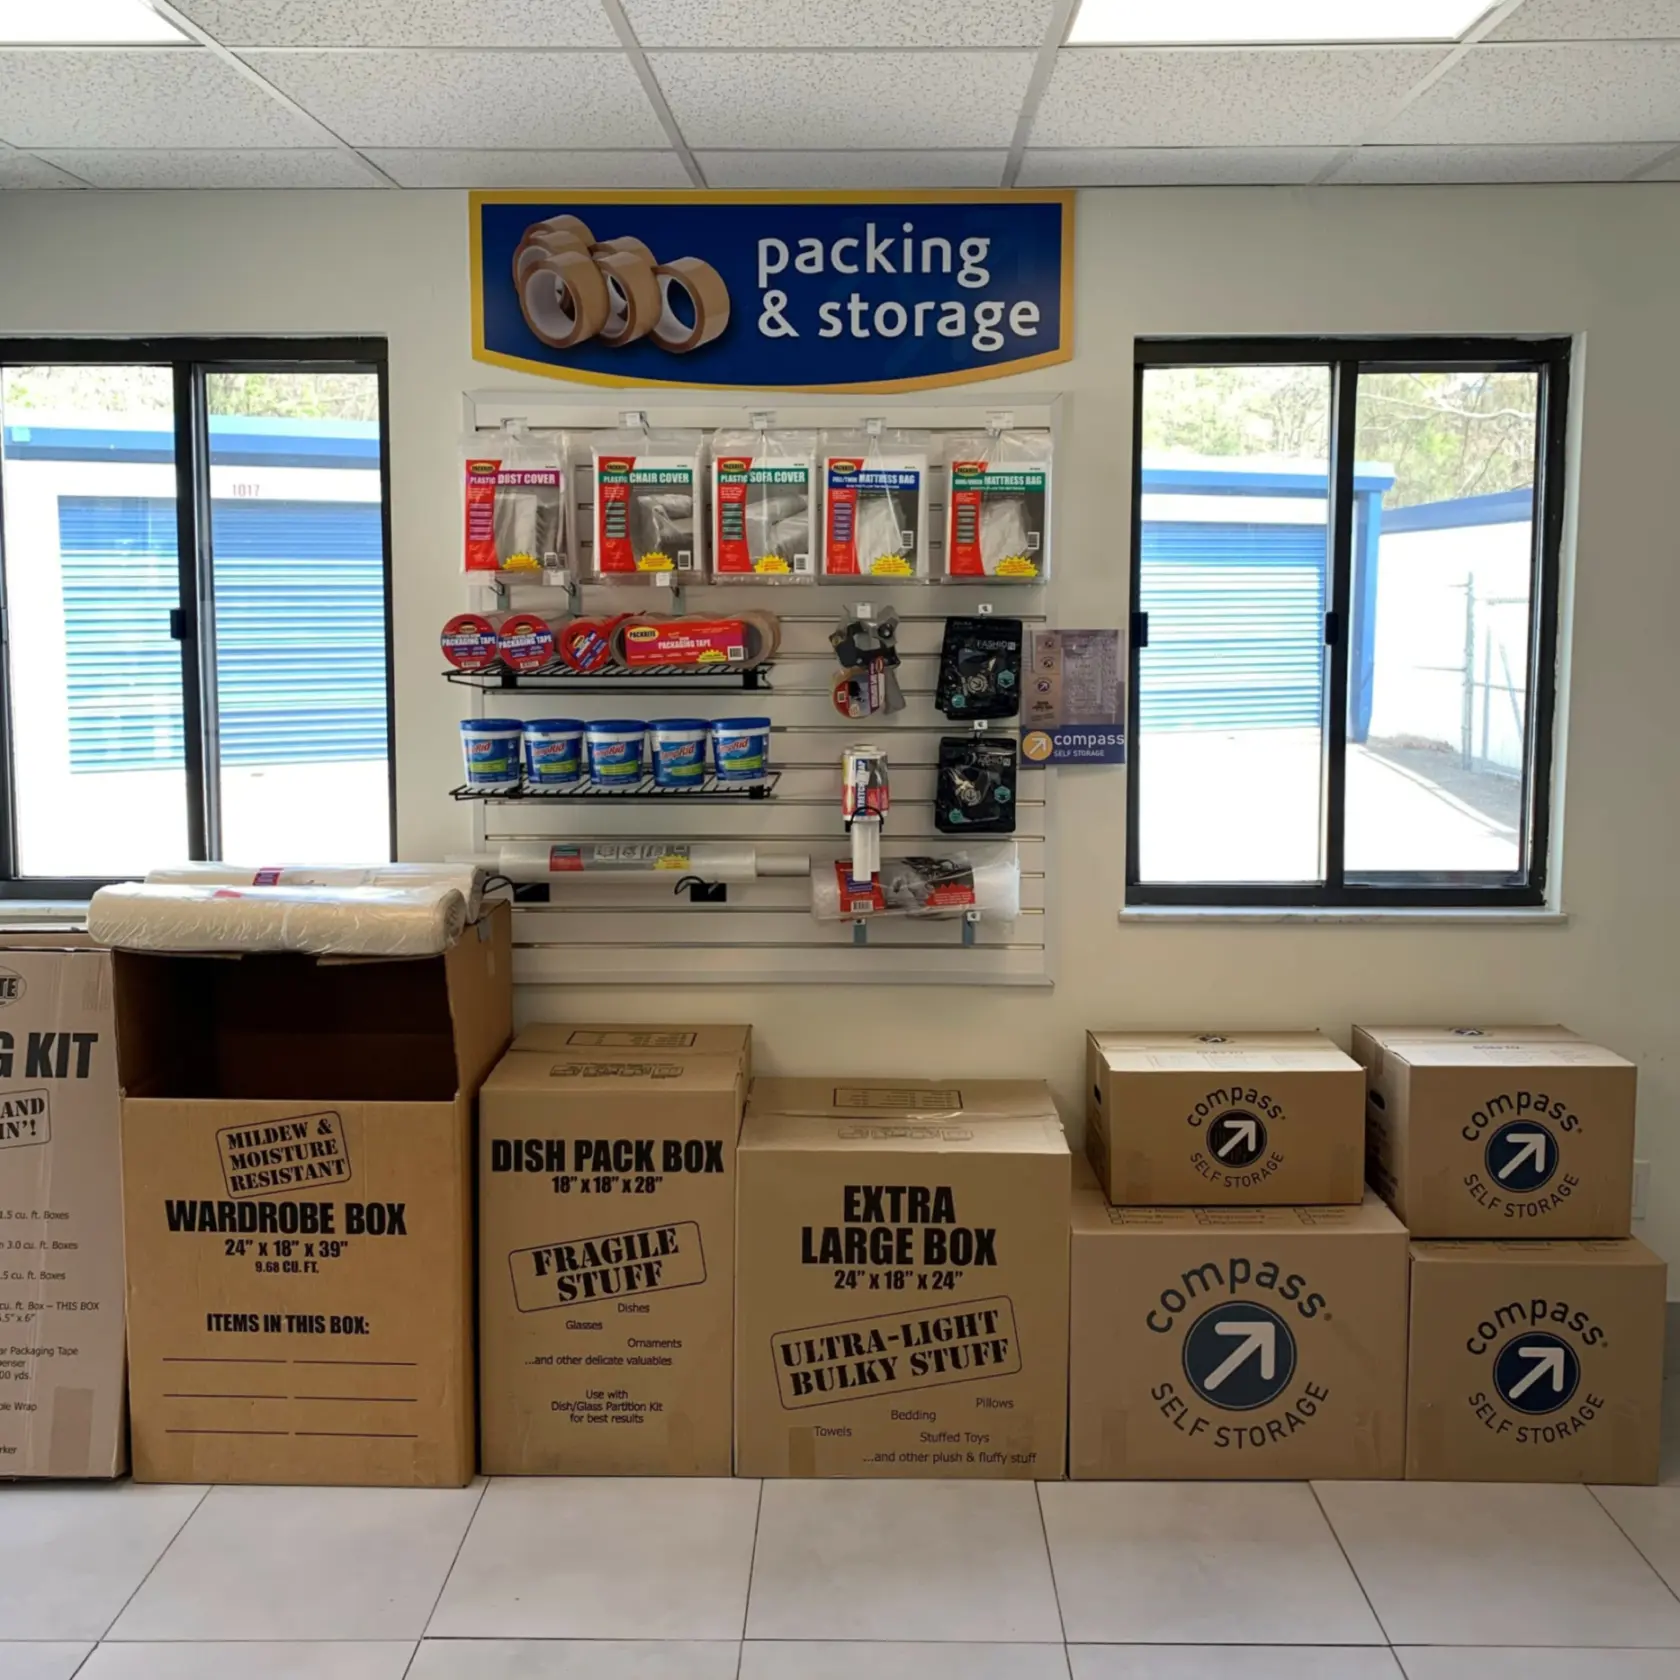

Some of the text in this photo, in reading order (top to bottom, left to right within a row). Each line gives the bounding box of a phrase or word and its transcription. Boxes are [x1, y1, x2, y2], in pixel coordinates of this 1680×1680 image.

[759, 223, 990, 288] packing
[758, 289, 1040, 352] & storage
[497, 473, 523, 484] DUST
[524, 473, 556, 484] COVER
[629, 472, 658, 483] CHAIR
[659, 473, 689, 483] COVER
[720, 471, 805, 483] PLASTIC SOFA COVER
[858, 473, 897, 484] MATTRESS
[898, 475, 915, 484] BAG
[984, 476, 1025, 485] MATTRESS
[1025, 476, 1042, 485] BAG
[232, 483, 260, 497] 1017
[481, 636, 496, 645] TAPE
[536, 635, 552, 644] TAPE
[658, 639, 711, 649] PACKAGING TAPE
[1054, 734, 1125, 748] compass
[1053, 749, 1105, 757] SELF STORAGE
[26, 1033, 98, 1078] KIT
[0, 1097, 45, 1119] AND
[1187, 1086, 1282, 1127] compass
[1462, 1091, 1579, 1141] compass
[226, 1117, 334, 1150] MILDEW &
[231, 1138, 338, 1171] MOISTURE
[491, 1139, 725, 1173] DISH PACK BOX
[230, 1159, 346, 1192] RESISTANT
[1190, 1151, 1284, 1188] SELF STORAGE
[552, 1176, 662, 1193] 18" x 18" x 28"
[1464, 1173, 1579, 1218] SELF STORAGE
[844, 1186, 956, 1223] EXTRA
[15, 1212, 28, 1220] cu.
[31, 1210, 41, 1219] ft.
[43, 1211, 70, 1220] Boxes
[165, 1198, 406, 1235] WARDROBE BOX
[7, 1240, 22, 1250] 3.0
[40, 1240, 48, 1249] ft.
[52, 1241, 79, 1250] Boxes
[225, 1239, 348, 1257] 24" x 18" x 39"
[802, 1227, 997, 1266] LARGE BOX
[532, 1229, 679, 1276] FRAGILE
[255, 1261, 319, 1273] 9.68 CU. FT.
[11, 1272, 24, 1280] cu.
[27, 1270, 36, 1280] ft.
[39, 1271, 66, 1280] Boxes
[557, 1261, 663, 1302] STUFF
[835, 1270, 962, 1289] 24" x 18" x 24"
[1146, 1257, 1326, 1333] compass
[15, 1301, 24, 1311] ft.
[27, 1301, 44, 1311] Box
[56, 1301, 78, 1311] THIS
[80, 1301, 100, 1311] BOX
[618, 1303, 649, 1313] Dishes
[24, 1313, 36, 1323] 6"
[207, 1314, 369, 1334] ITEMS IN THIS BOX:
[566, 1320, 602, 1329] Glasses
[1466, 1298, 1604, 1355] compass
[628, 1338, 682, 1348] Ornaments
[781, 1310, 999, 1367] ULTRA-LIGHT
[10, 1346, 55, 1358] Packaging
[57, 1347, 79, 1357] Tape
[525, 1355, 672, 1365] ...and other delicate valuables
[791, 1338, 1009, 1396] BULKY STUFF
[586, 1390, 628, 1399] Use with
[13, 1402, 38, 1412] Wrap
[551, 1400, 664, 1412] Dish/Glass Partition Kit
[976, 1398, 1014, 1408] Pillows
[569, 1413, 645, 1424] for best results
[891, 1410, 936, 1422] Bedding
[1151, 1381, 1329, 1449] SELF STORAGE
[1469, 1392, 1605, 1444] SELF STORAGE
[814, 1426, 852, 1436] Towels
[920, 1432, 989, 1445] Stuffed Toys
[864, 1452, 1036, 1464] ...and other plush & fluffy stuff
